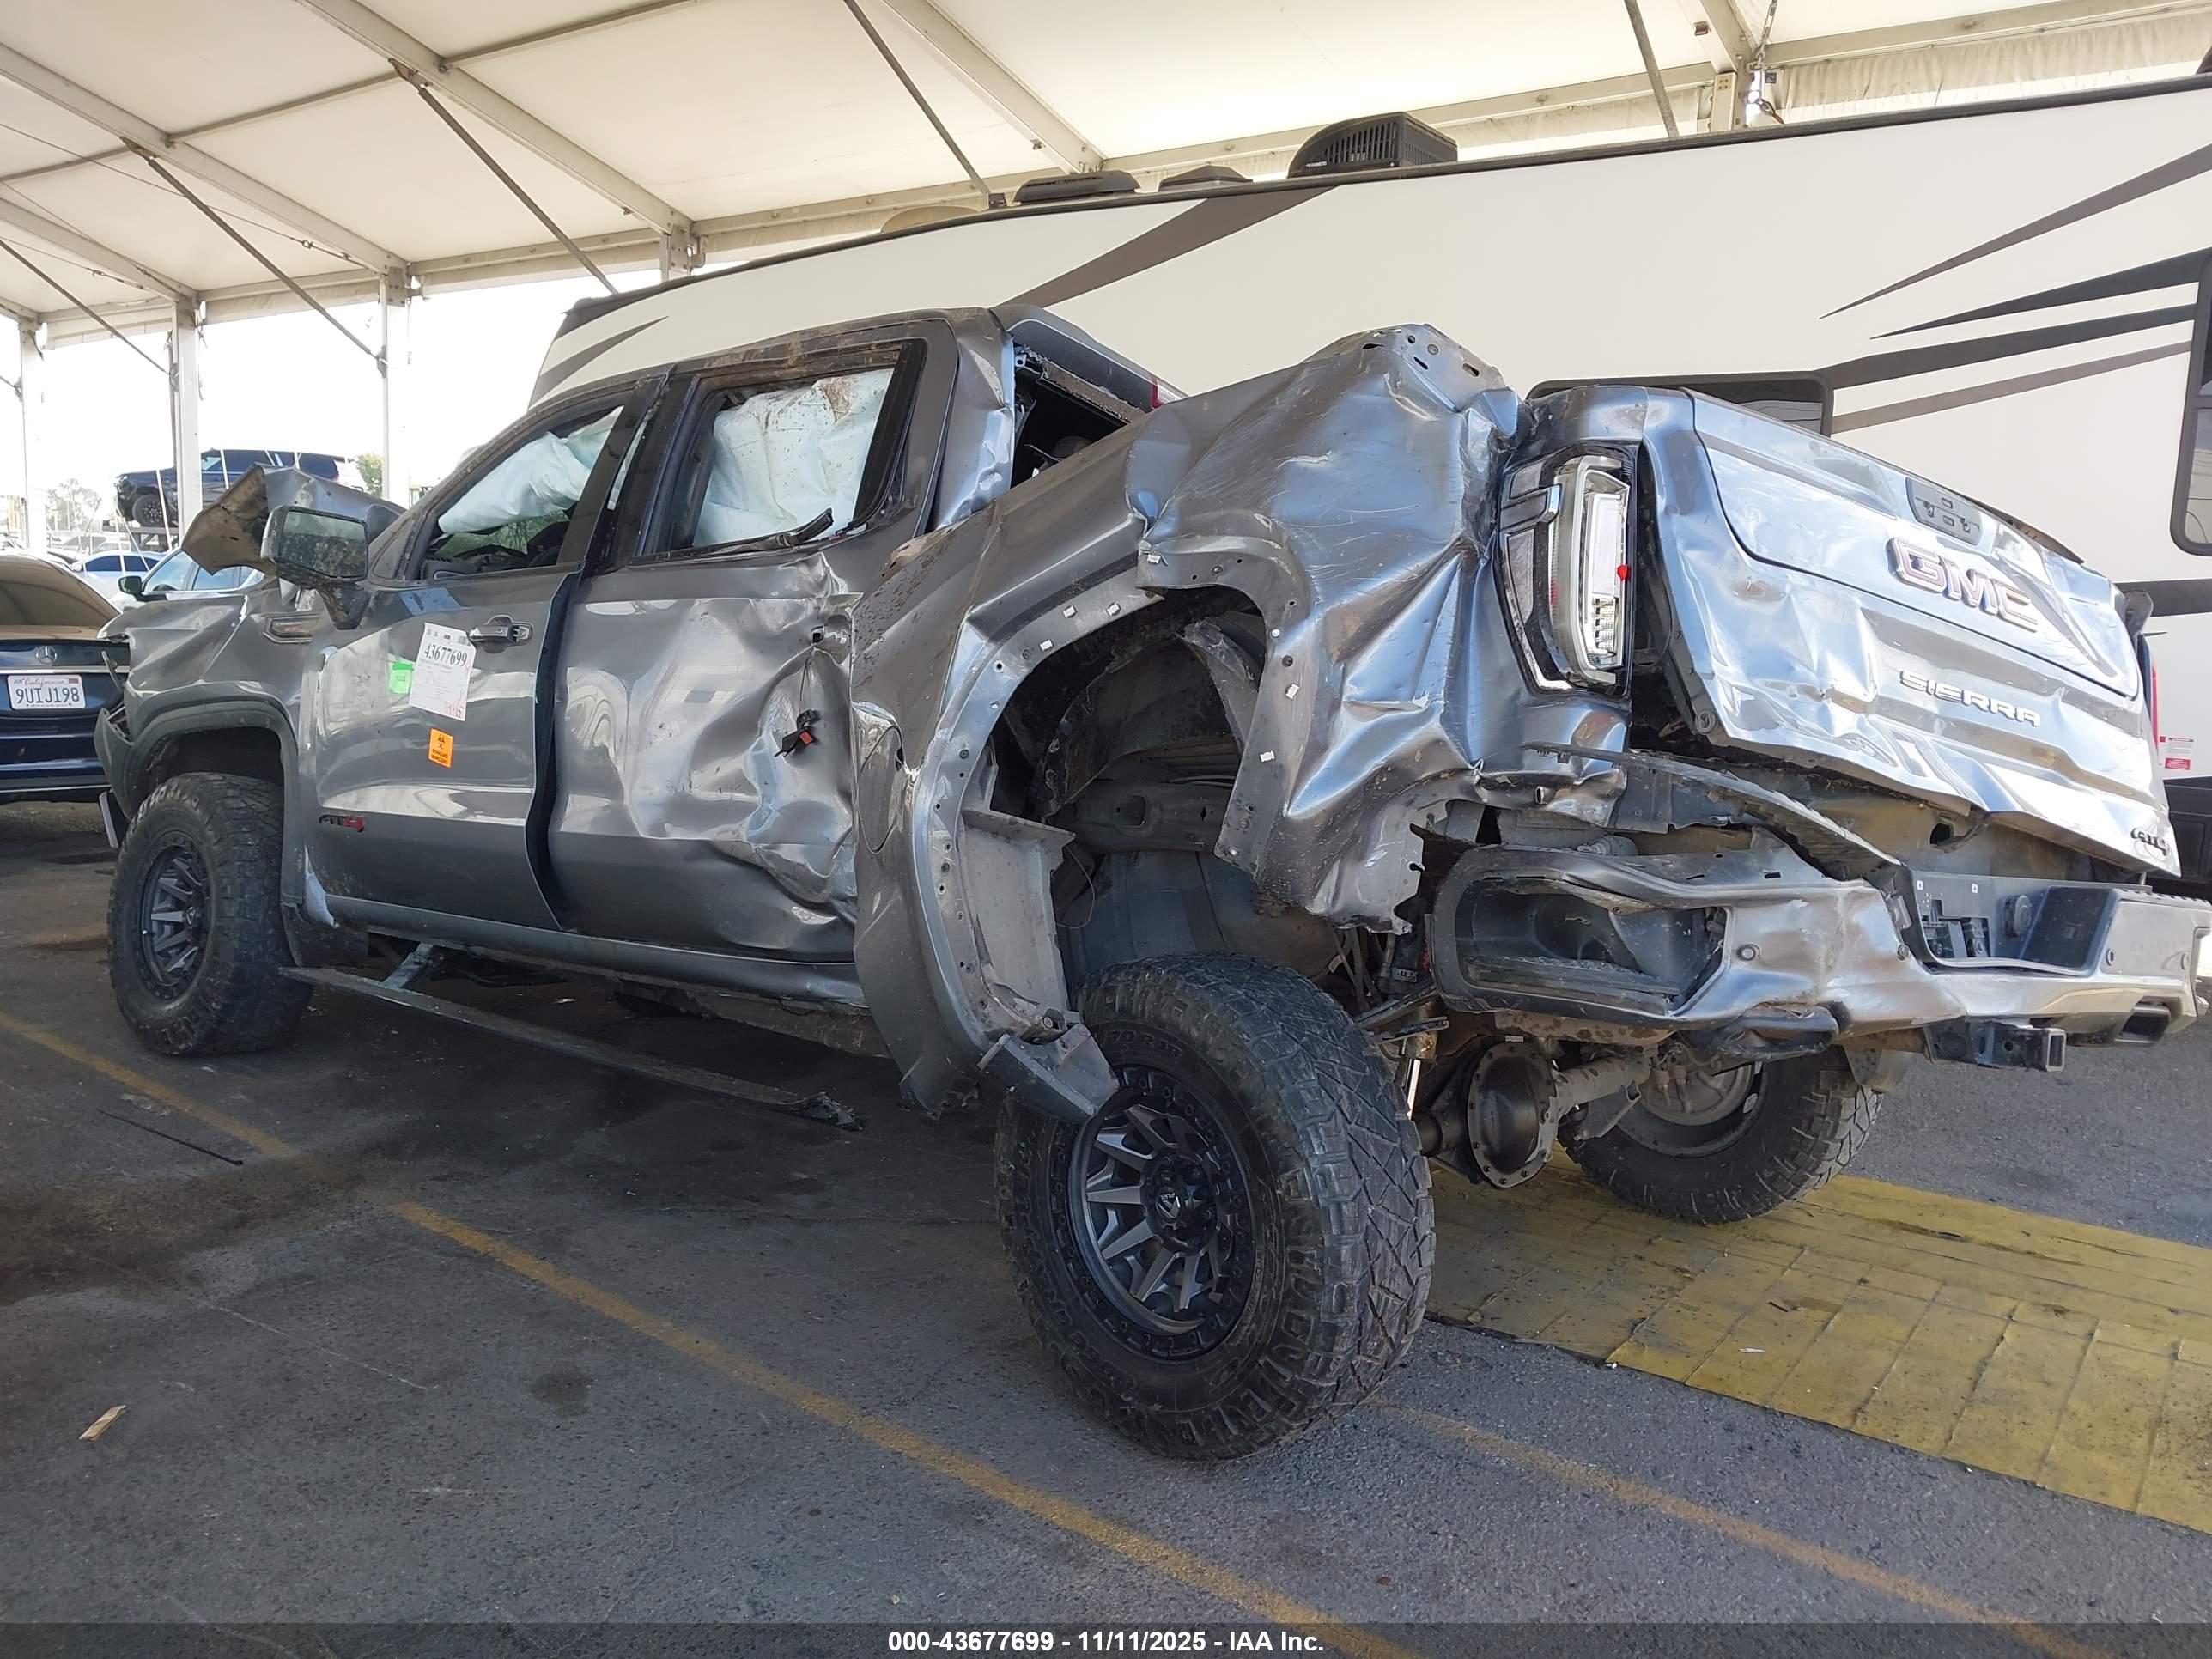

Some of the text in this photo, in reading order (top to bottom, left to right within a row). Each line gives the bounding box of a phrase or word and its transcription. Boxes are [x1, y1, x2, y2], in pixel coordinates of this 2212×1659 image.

[1887, 537, 2039, 633] GMC
[424, 642, 468, 667] 43677699
[15, 687, 80, 704] 9UIJ198
[1899, 670, 2043, 727] SIERRA
